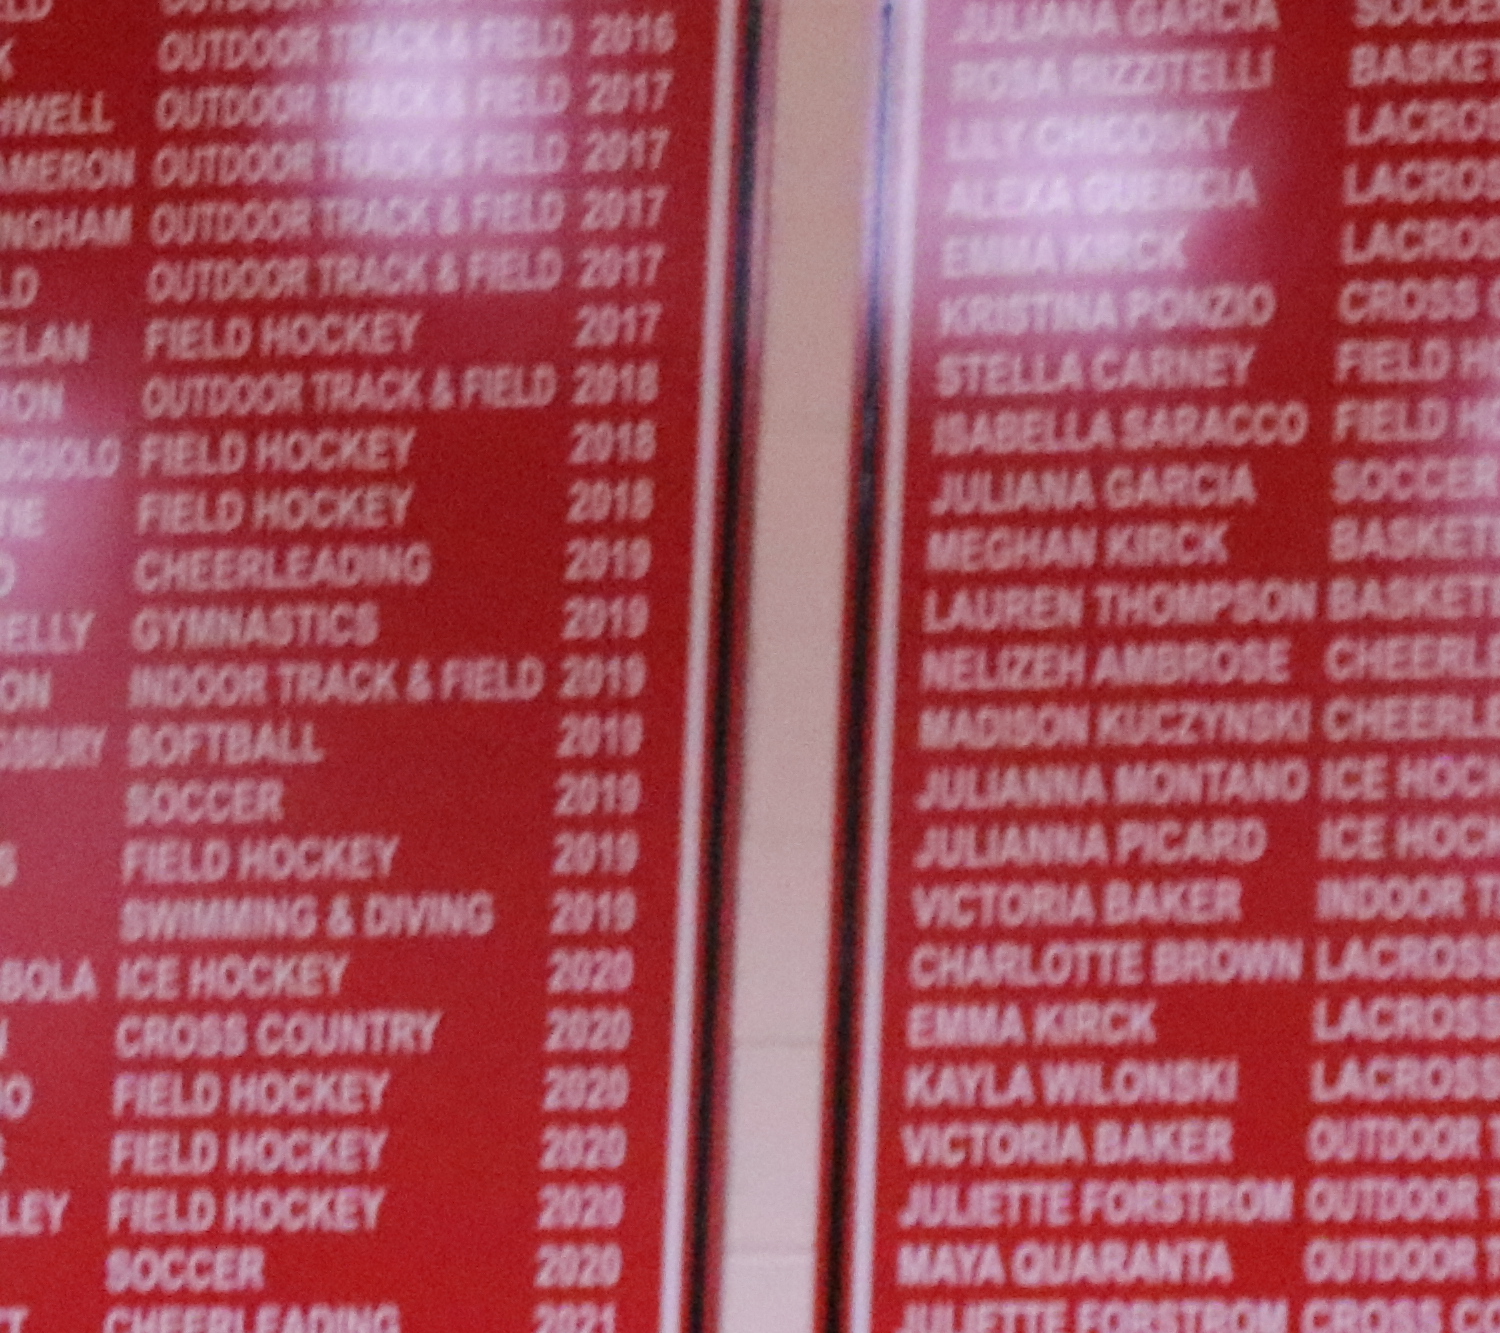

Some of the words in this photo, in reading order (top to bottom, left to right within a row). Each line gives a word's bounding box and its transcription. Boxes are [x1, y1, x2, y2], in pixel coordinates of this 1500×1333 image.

[1338, 277, 1479, 324] CROSS
[145, 317, 252, 360] FIELD
[261, 311, 420, 356] HOCKEY
[575, 302, 662, 347] 2017
[141, 373, 304, 419] OUTDOOR
[311, 369, 421, 411] TRACK
[429, 368, 454, 410] &
[462, 364, 556, 408] FIELD
[572, 361, 658, 405] 2018
[138, 431, 247, 476] FIELD
[256, 427, 415, 472] HOCKEY
[569, 419, 656, 464] 2018
[932, 468, 1095, 515] JULIANA
[1104, 463, 1256, 509] GARCIA
[1332, 459, 1500, 503] SOCCER
[133, 542, 431, 593] CHEERLEADING
[565, 537, 652, 581] 2019
[131, 602, 378, 651] GYMNASTICS
[562, 595, 649, 640] 2019
[925, 585, 1083, 632] LAUREN
[1094, 578, 1312, 626] THOMPSON
[129, 663, 267, 709] INDOOR
[277, 661, 397, 704] TRACK
[406, 659, 432, 702] &
[441, 656, 544, 702] FIELD
[559, 654, 646, 698] 2019
[127, 721, 324, 768] SOFTBALL
[557, 713, 643, 757] 2019
[125, 779, 284, 826] SOCCER
[555, 772, 641, 815] 2019
[915, 823, 1108, 869] JULIANNA
[1117, 818, 1267, 863] PICARD
[1319, 815, 1385, 860] ICE
[120, 895, 317, 942] SWIMMING
[327, 895, 354, 938] &
[364, 891, 494, 937] DIVING
[550, 889, 636, 934] 2019
[913, 882, 1095, 928] VICTORIA
[1103, 878, 1242, 925] BAKER
[1317, 875, 1466, 921] INDOOR
[117, 956, 178, 1000] ICE
[189, 953, 348, 999] HOCKEY
[548, 949, 633, 993] 2020
[910, 940, 1142, 988] CHARLOTTE
[1153, 938, 1303, 984] BROWN
[115, 1013, 247, 1059] CROSS
[256, 1010, 441, 1056] COUNTRY
[545, 1007, 631, 1052] 2020
[908, 1003, 1025, 1048] EMMA
[1033, 1000, 1155, 1045] KIRCK
[113, 1072, 221, 1117] FIELD
[229, 1070, 390, 1115] HOCKEY
[543, 1066, 629, 1111] 2020
[905, 1063, 1034, 1107] KAYLA
[1042, 1059, 1238, 1105] WILONSKI
[899, 1180, 1071, 1227] JULIETTE
[1081, 1177, 1294, 1225] FORSTROM
[1305, 1175, 1479, 1222] OUTDOOR
[106, 1247, 265, 1293] SOCCER
[535, 1243, 621, 1288] 2020
[897, 1243, 1005, 1286] MAYA
[1011, 1239, 1232, 1287] QUARANTA
[1304, 1236, 1477, 1283] OUTDOOR
